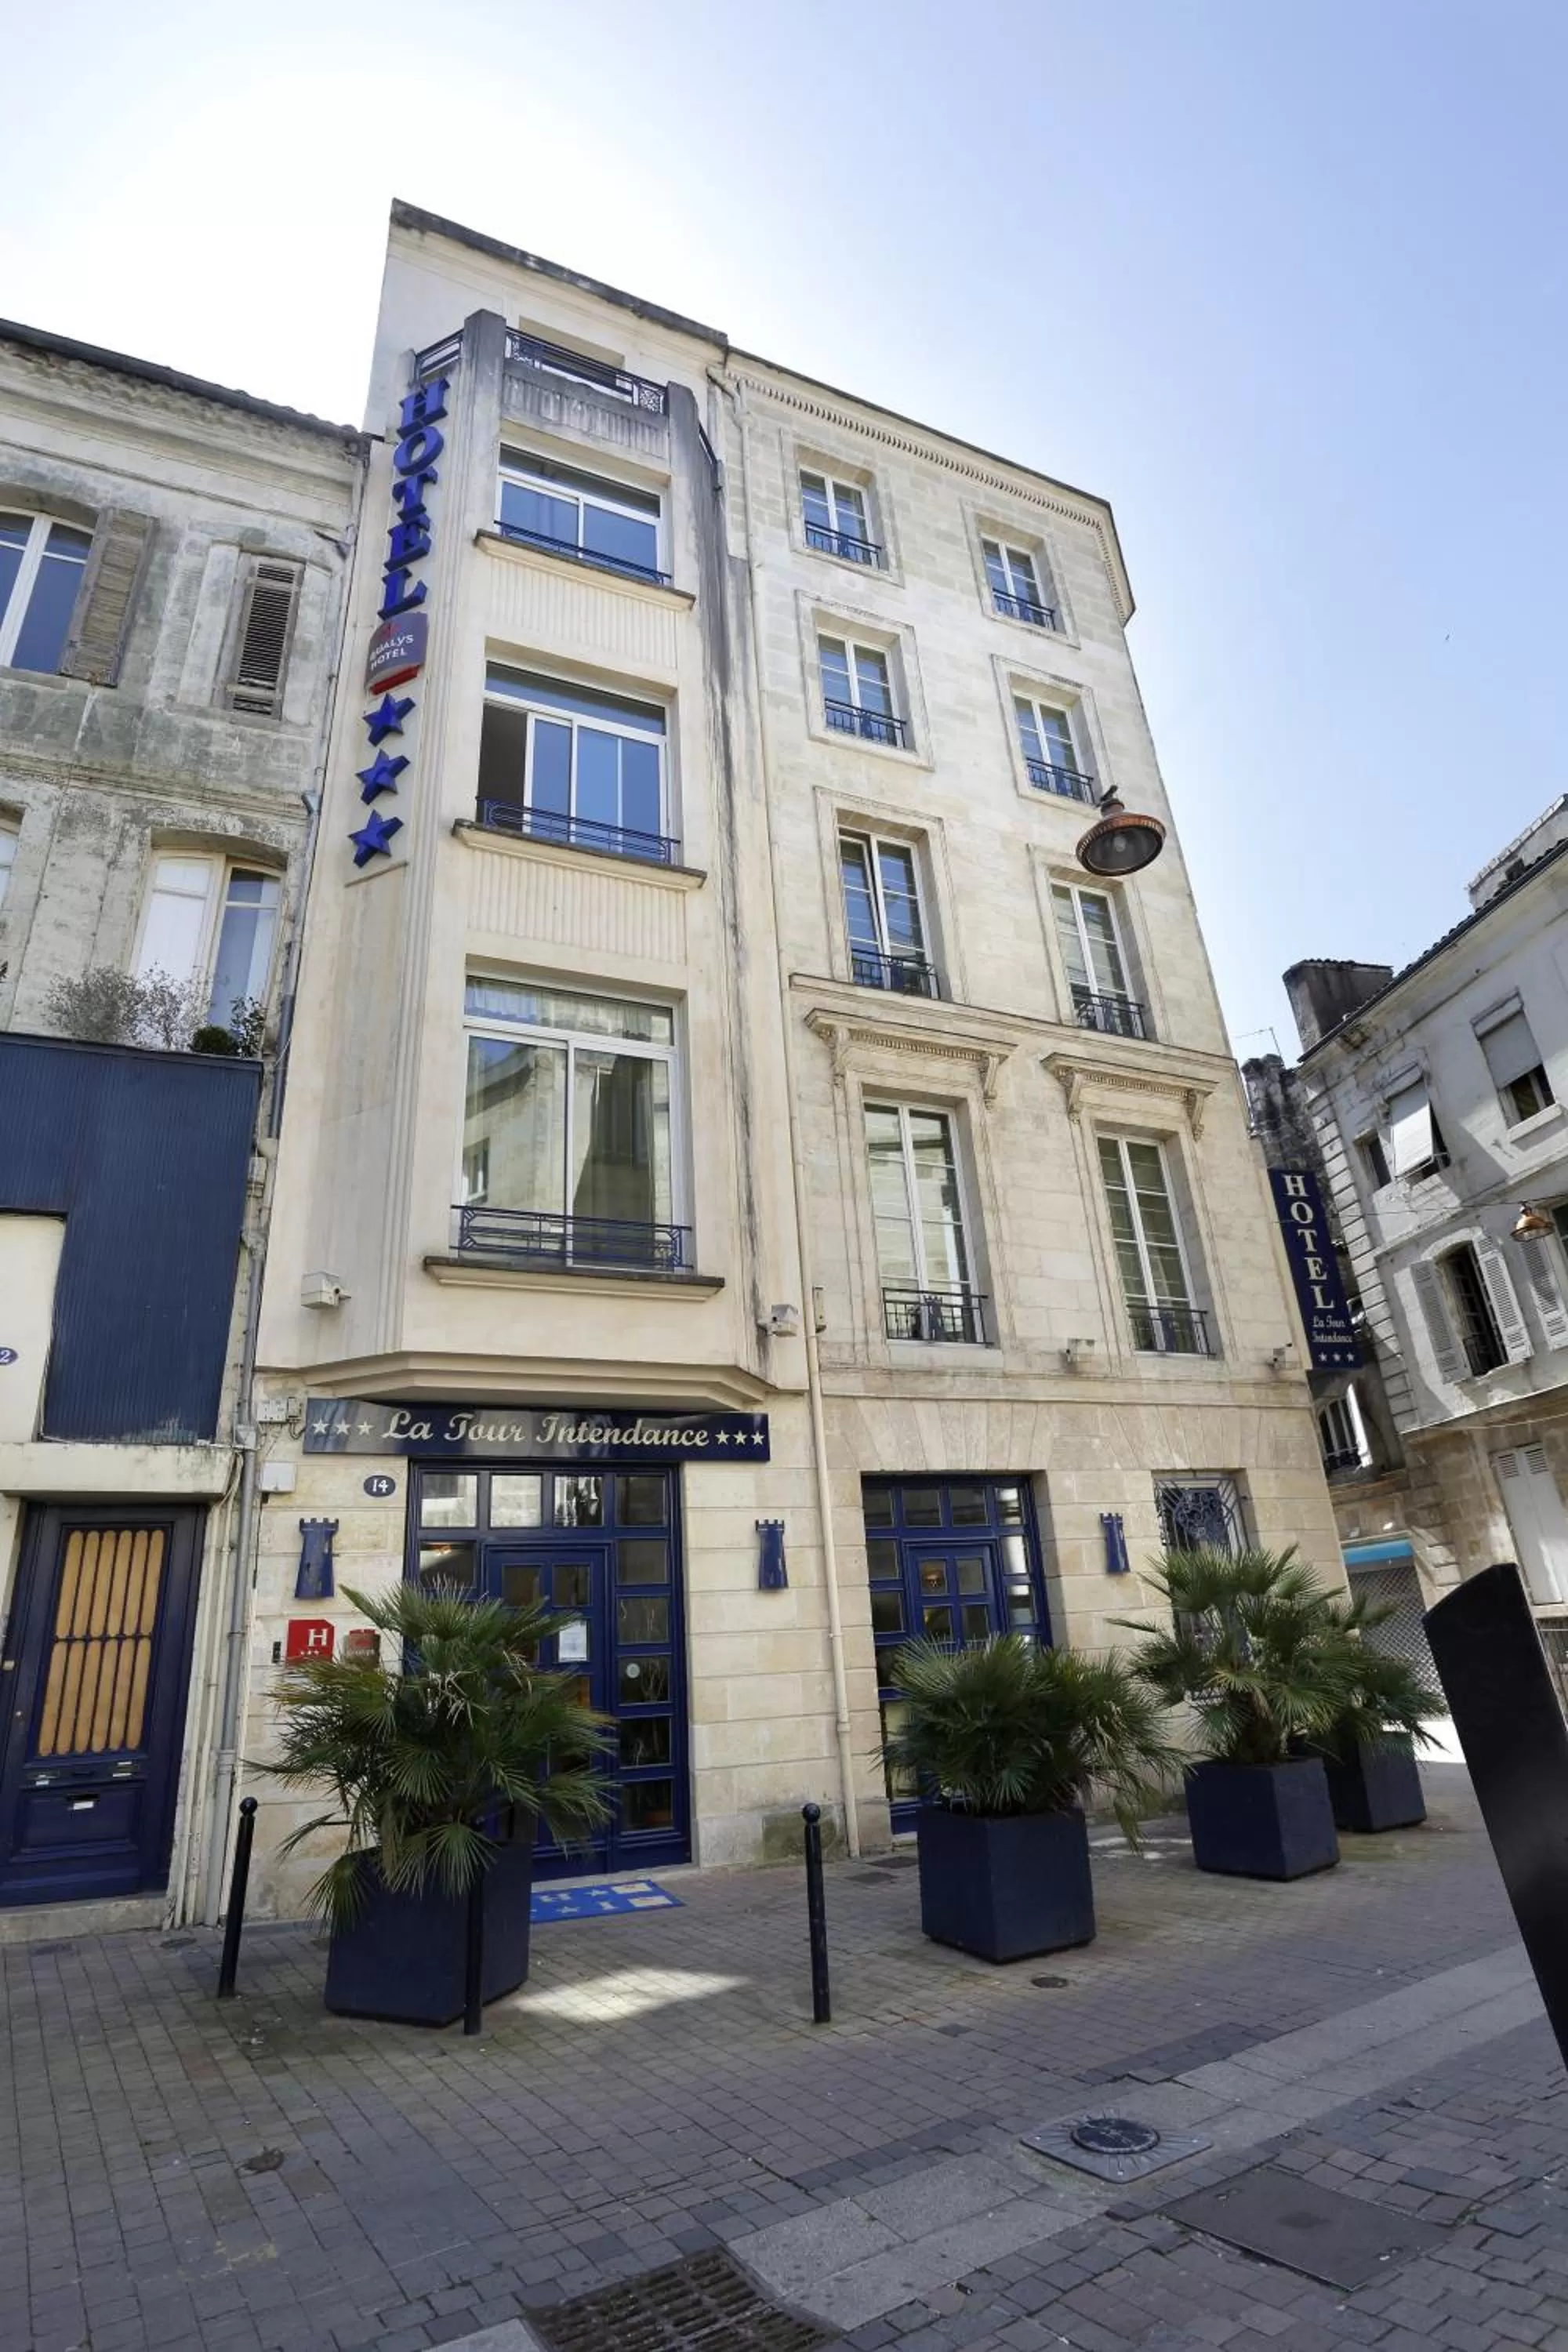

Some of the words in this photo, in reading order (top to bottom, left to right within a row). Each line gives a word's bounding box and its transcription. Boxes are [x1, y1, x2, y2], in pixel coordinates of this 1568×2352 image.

[378, 378, 450, 620] HOTEL
[1283, 1174, 1335, 1308] HOTEL
[382, 1410, 433, 1440] La
[444, 1414, 525, 1443] Tour
[535, 1415, 710, 1446] Intendance
[372, 1479, 389, 1493] 14
[308, 1628, 328, 1647] H
